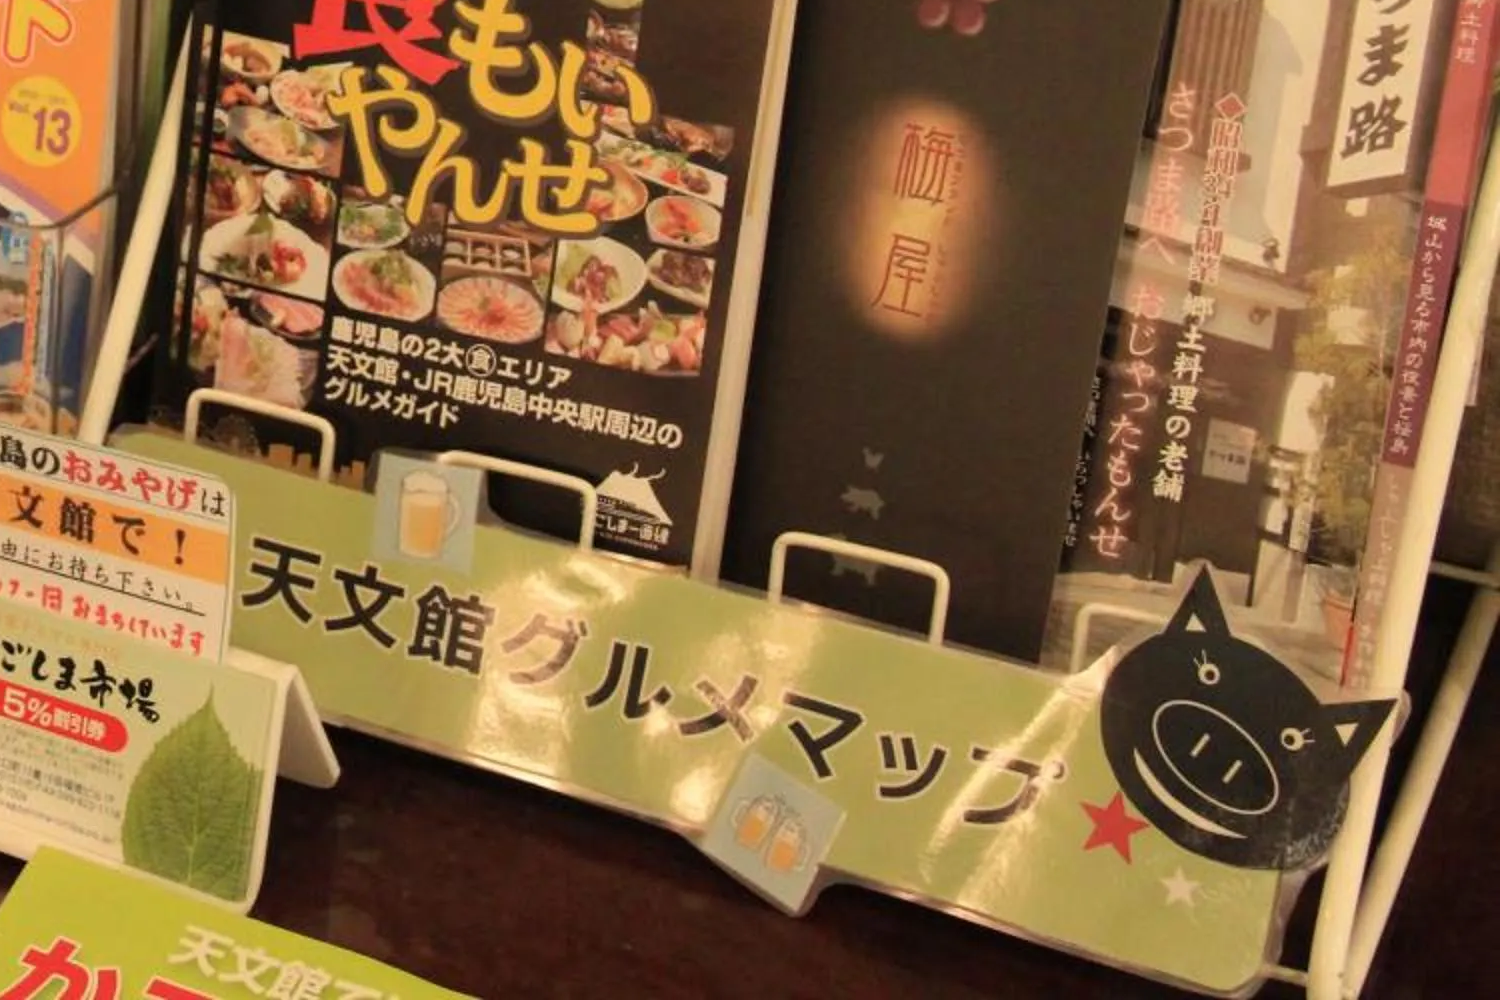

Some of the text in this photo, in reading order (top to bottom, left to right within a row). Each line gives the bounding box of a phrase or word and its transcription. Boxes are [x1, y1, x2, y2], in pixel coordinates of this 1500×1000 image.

[33, 107, 72, 155] 13
[325, 63, 609, 231] やんせ
[325, 378, 460, 429] グルメガイド
[327, 345, 682, 449] 天文館・JR鹿児島中央駅周辺の
[1151, 296, 1216, 504] 郷土料理の老舗
[73, 595, 205, 657] おまちしています
[3, 685, 106, 744] 5%割引券
[240, 534, 1068, 827] 天文館グルメマップ
